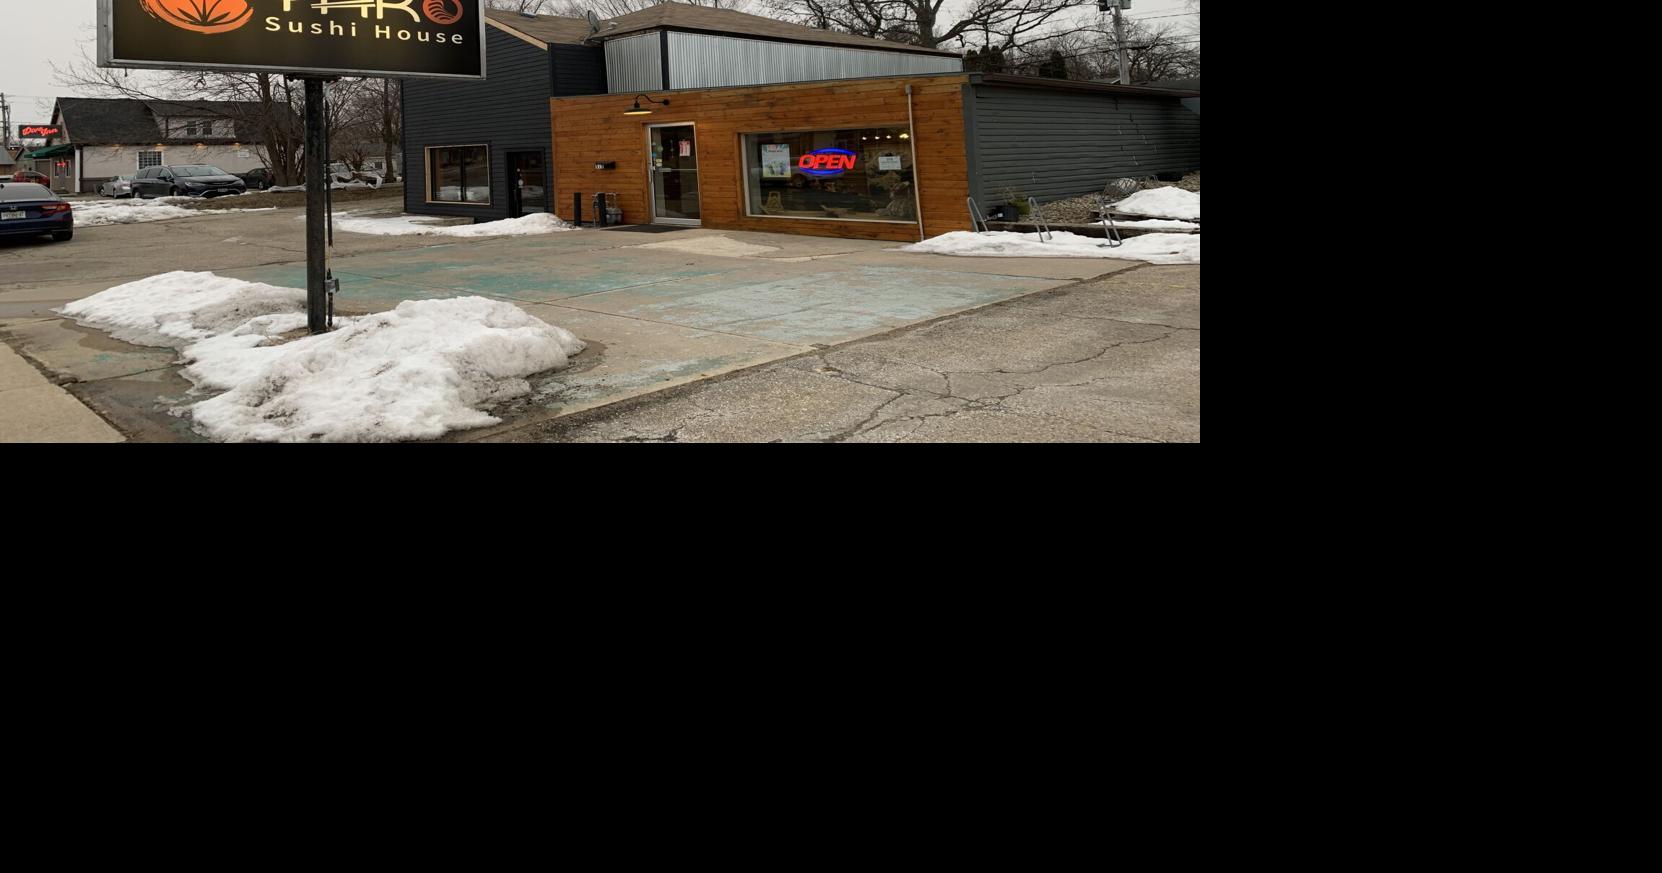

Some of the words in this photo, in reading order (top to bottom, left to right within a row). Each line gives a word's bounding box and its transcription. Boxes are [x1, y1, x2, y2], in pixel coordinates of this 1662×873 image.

[265, 16, 356, 37] Sushi
[375, 25, 464, 45] House
[798, 154, 857, 170] OPEN
